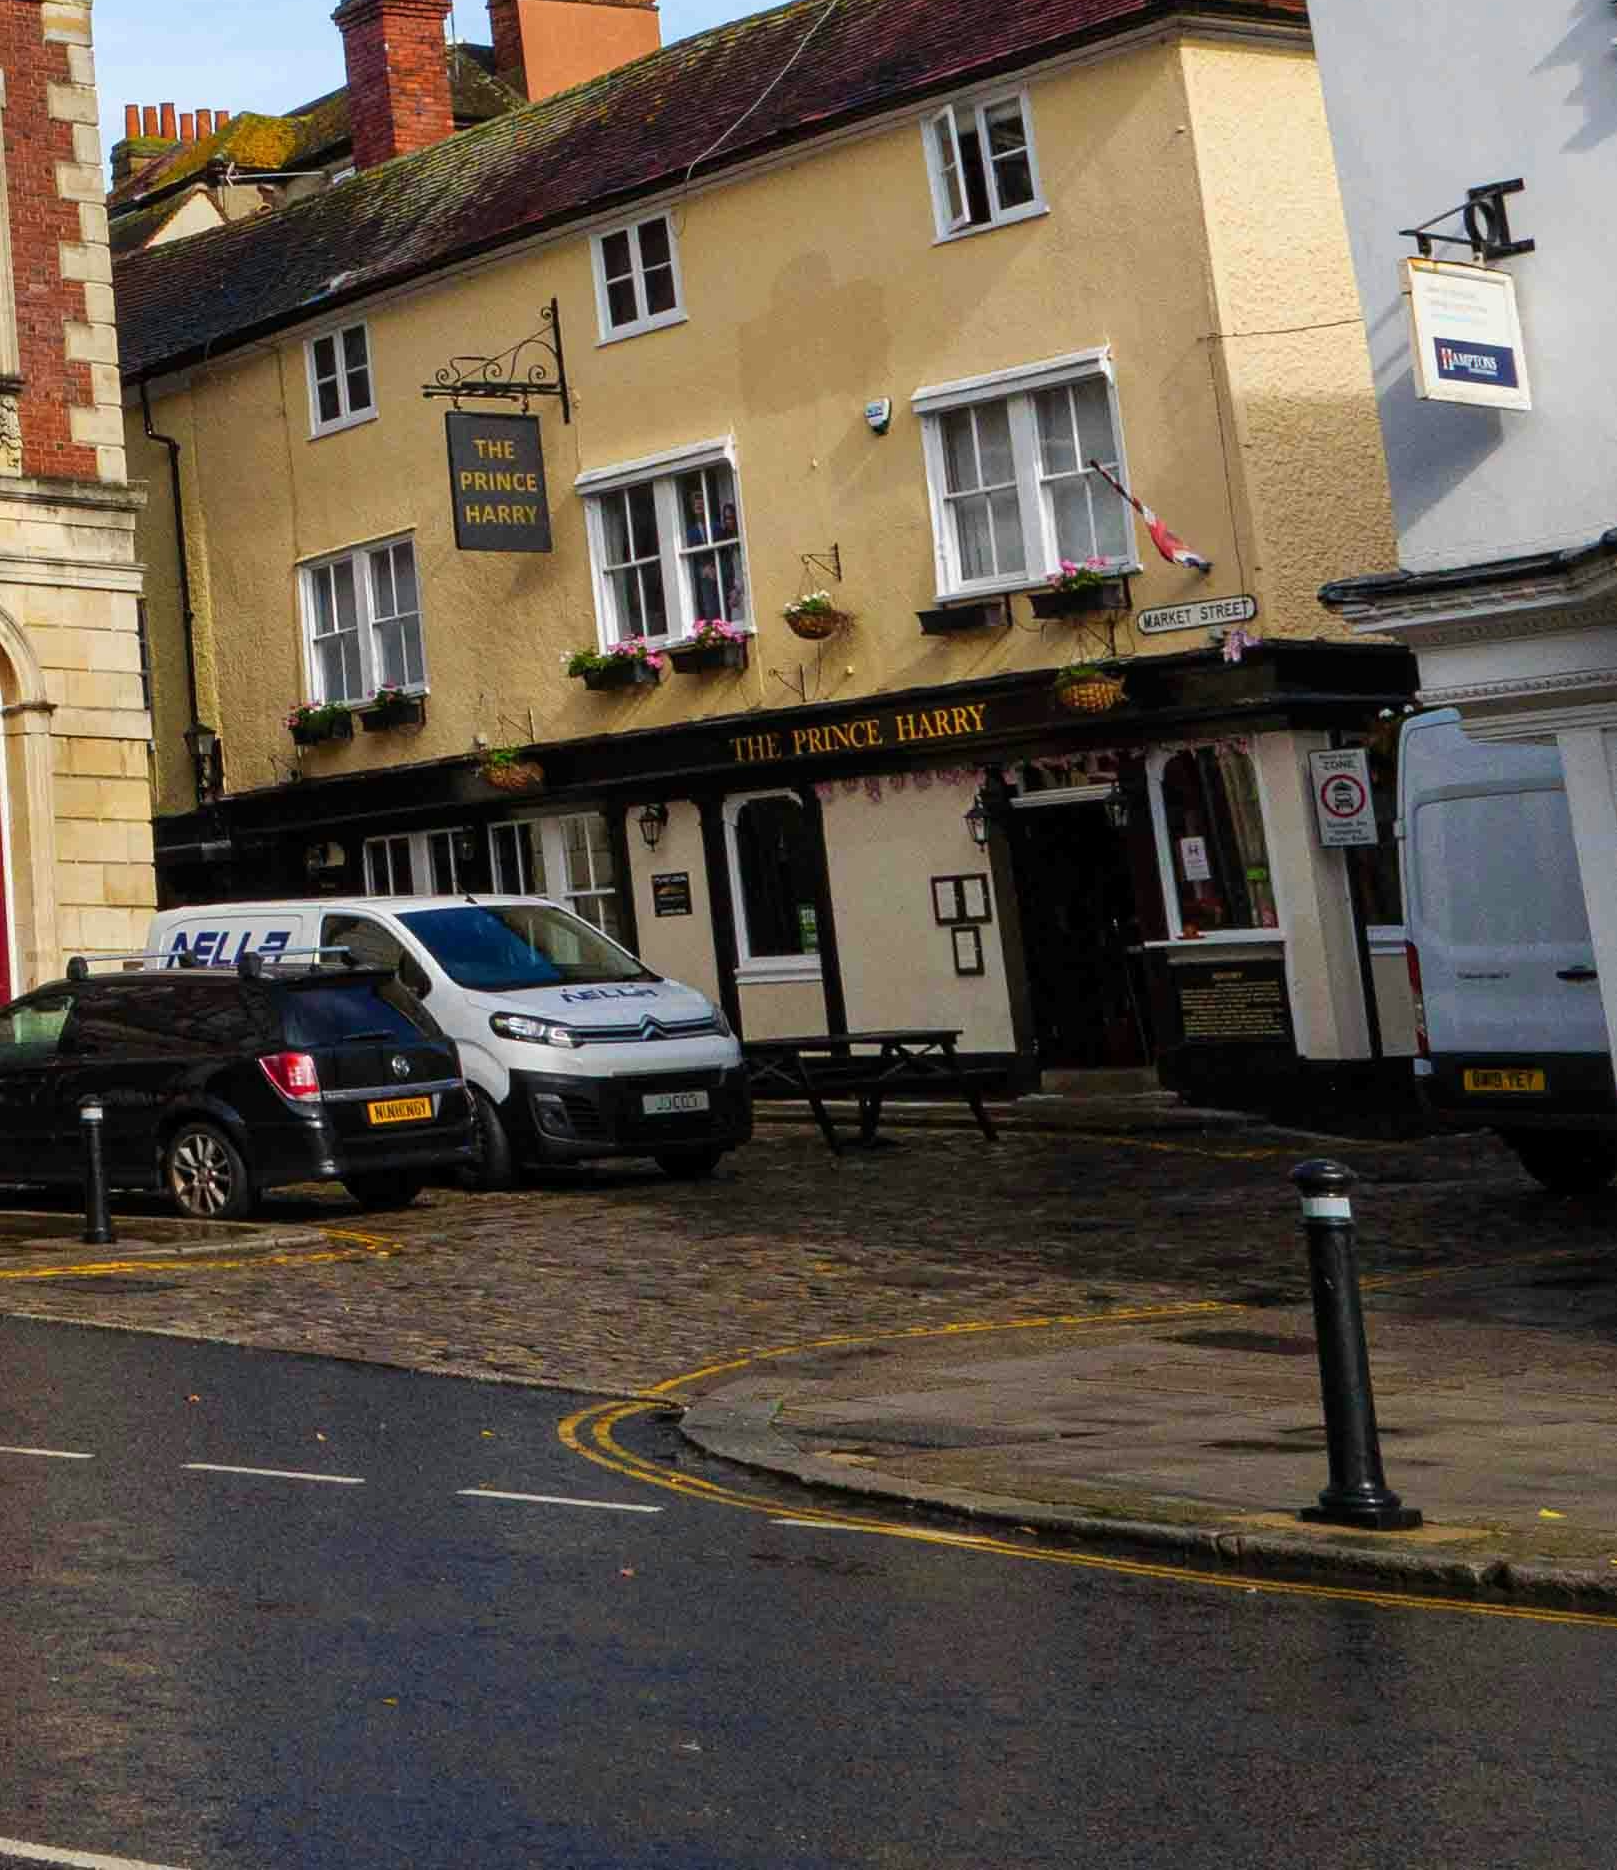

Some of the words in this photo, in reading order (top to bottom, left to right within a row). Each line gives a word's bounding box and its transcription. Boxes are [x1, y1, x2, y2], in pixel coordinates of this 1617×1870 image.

[471, 439, 514, 459] THE
[460, 471, 538, 491] PRINCE
[465, 504, 537, 523] HARRY
[1143, 609, 1192, 628] MARKET
[1200, 600, 1249, 620] STREET
[730, 735, 782, 762] THE
[791, 720, 883, 755] PRINCE
[896, 704, 985, 741] HARRY
